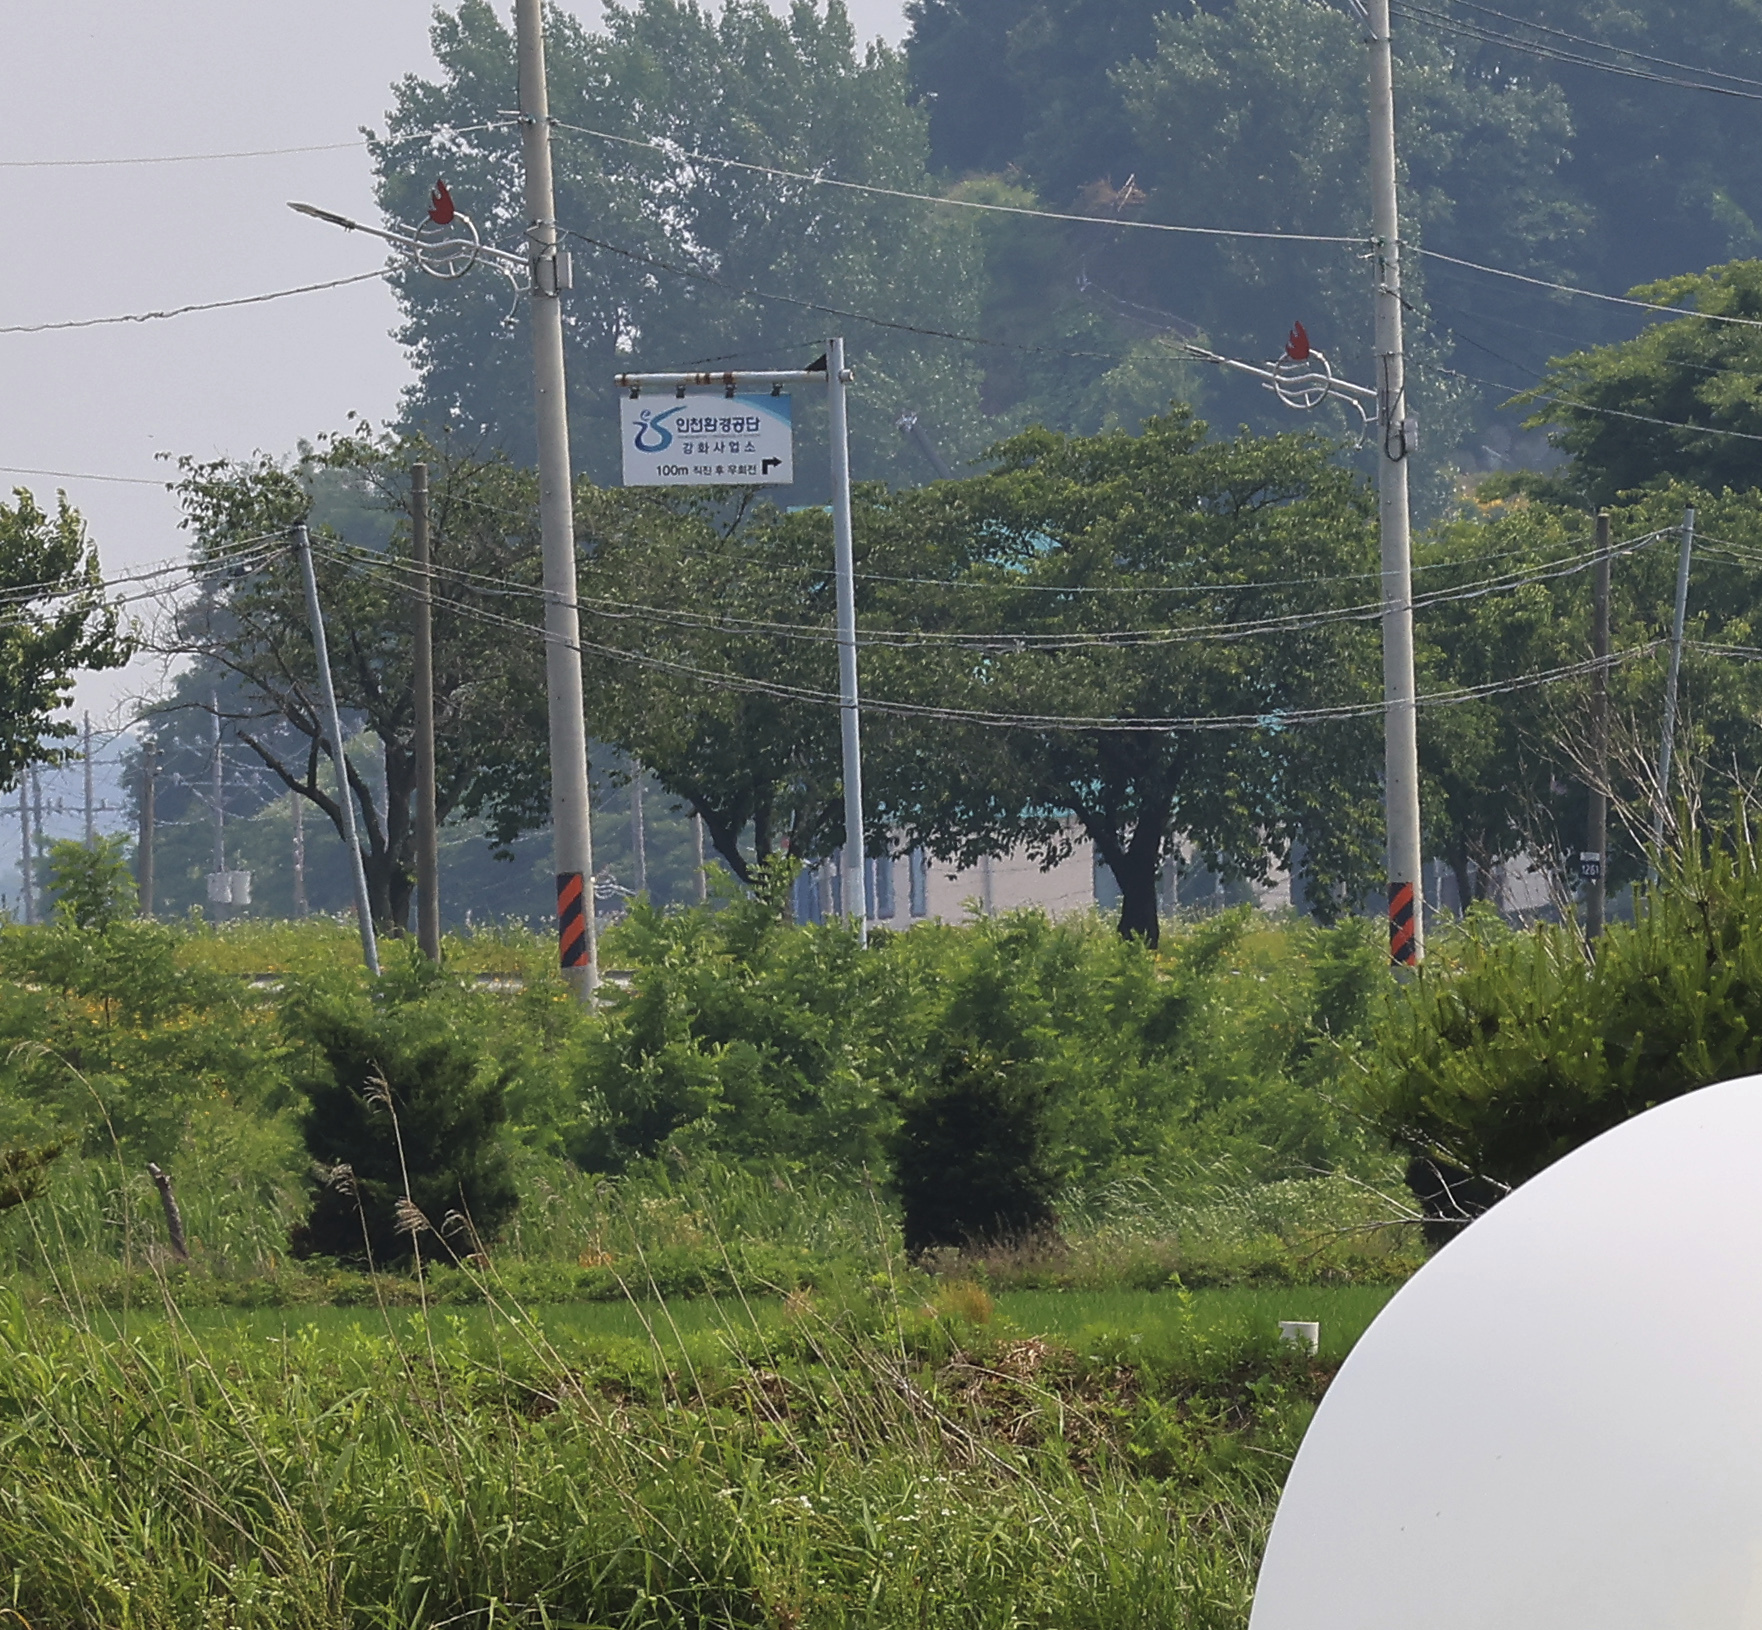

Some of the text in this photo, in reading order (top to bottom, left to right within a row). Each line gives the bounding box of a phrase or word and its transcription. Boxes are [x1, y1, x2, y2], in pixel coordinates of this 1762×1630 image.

[676, 416, 760, 433] 인천환경공단
[656, 464, 757, 476] 100m 직진 후 우회전
